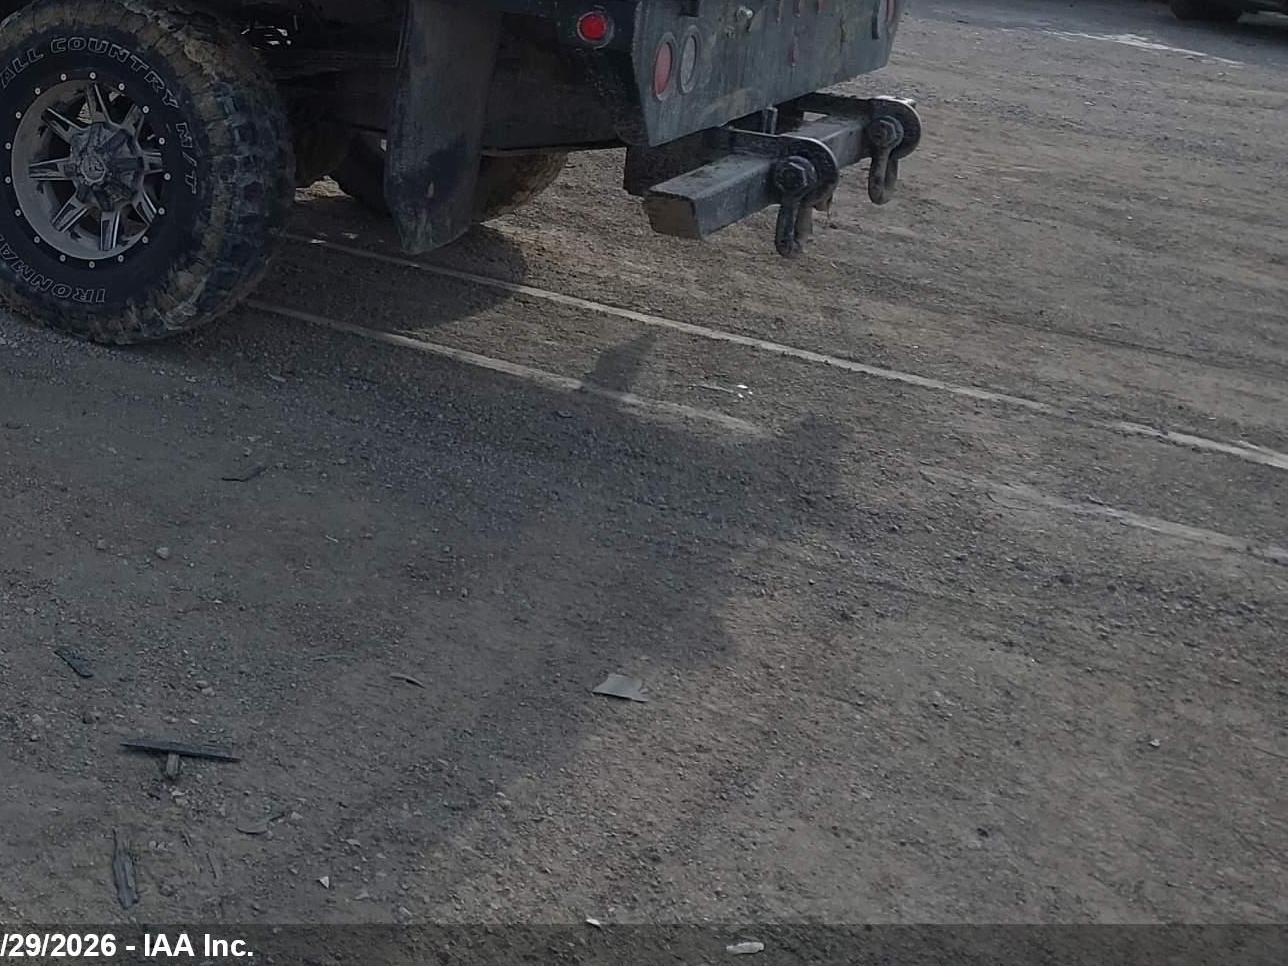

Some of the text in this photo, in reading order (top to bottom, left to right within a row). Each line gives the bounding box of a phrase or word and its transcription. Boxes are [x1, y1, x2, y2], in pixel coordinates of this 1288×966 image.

[0, 37, 204, 195] ALL COUNTRY M/T
